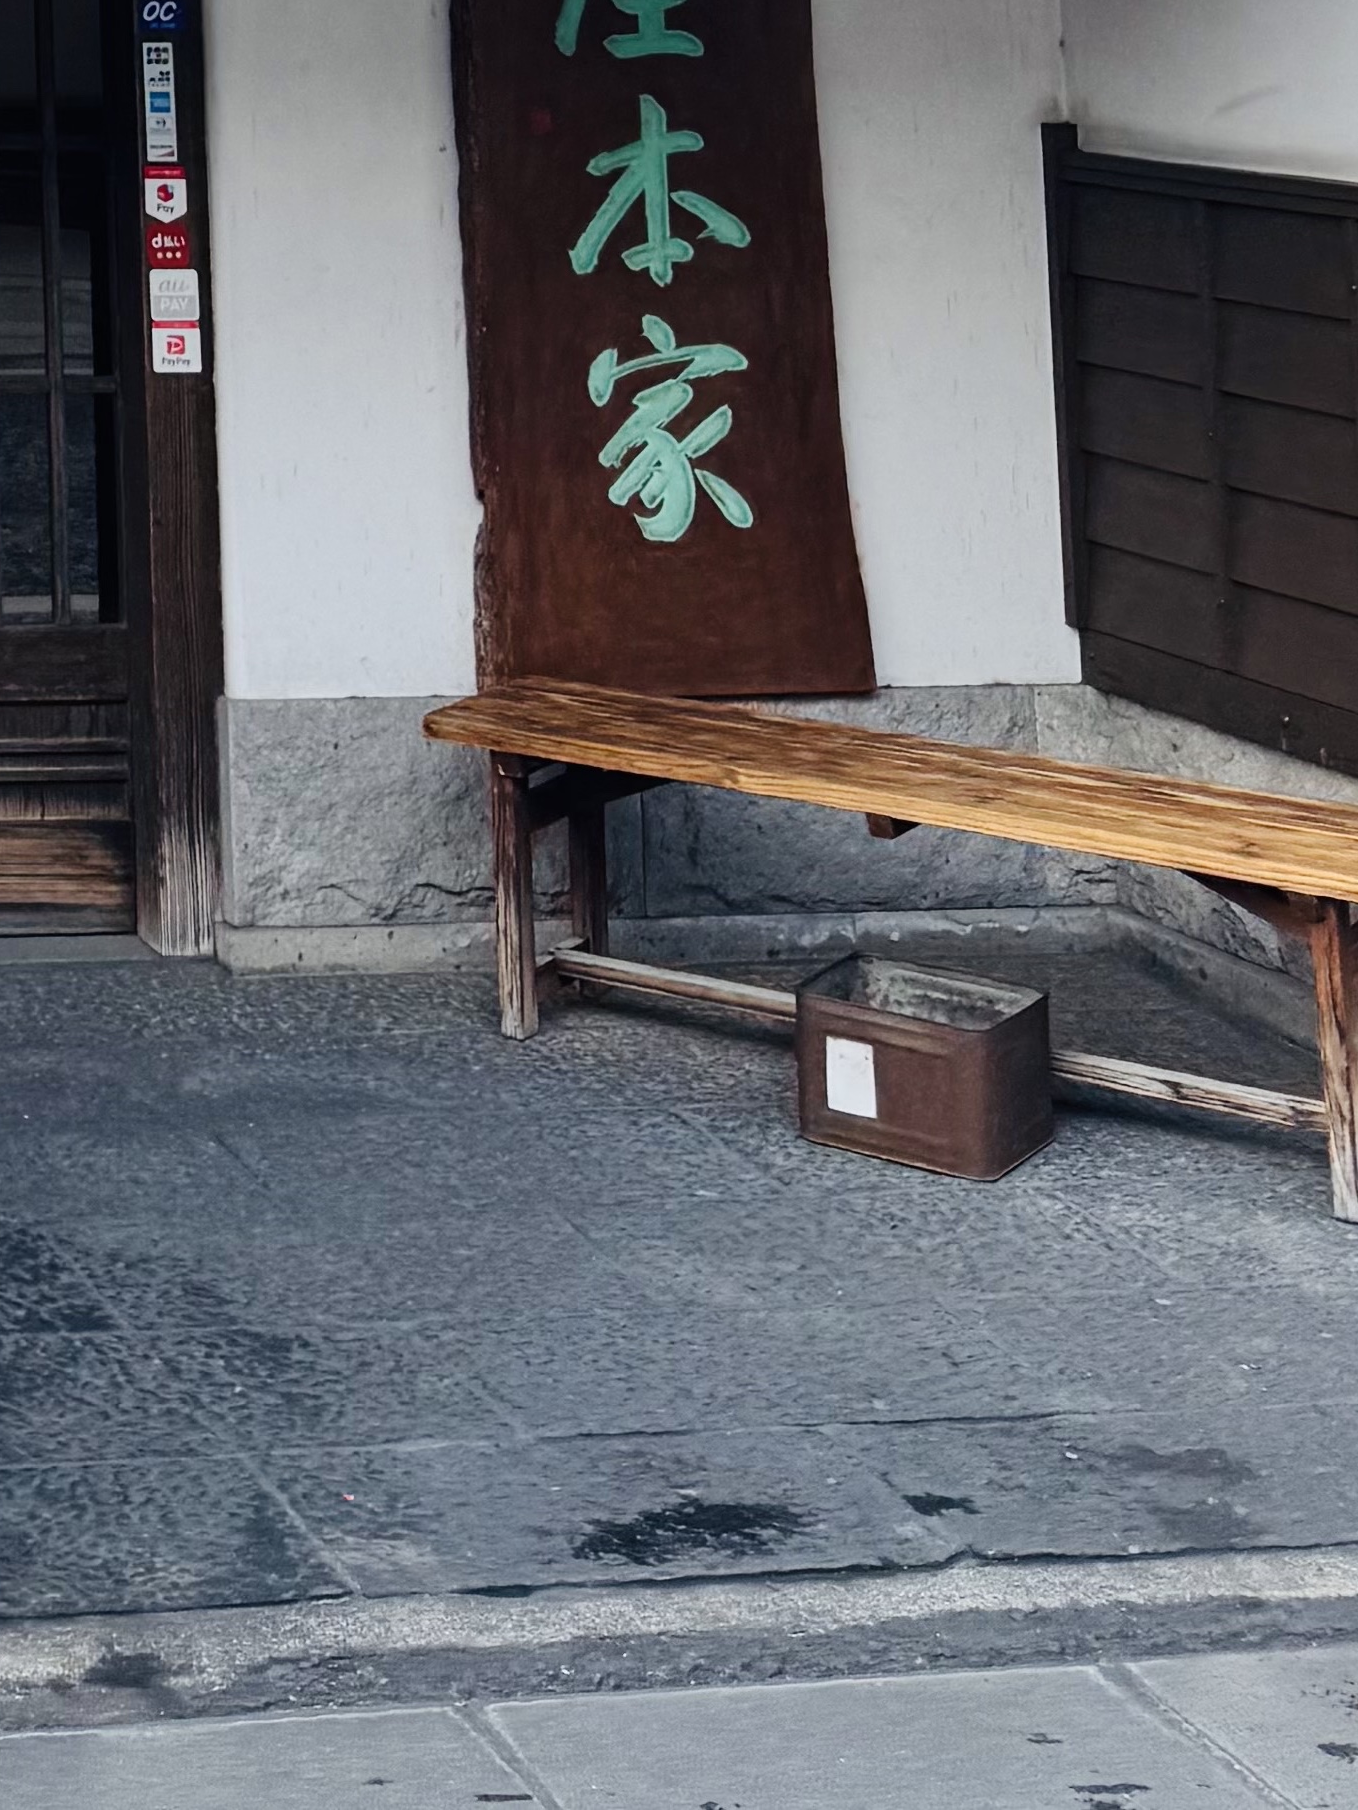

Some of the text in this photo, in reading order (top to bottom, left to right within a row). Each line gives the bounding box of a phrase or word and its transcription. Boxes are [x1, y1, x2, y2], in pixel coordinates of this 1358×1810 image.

[156, 204, 175, 215] Pay
[151, 232, 186, 249] d払い
[160, 297, 188, 311] PAY
